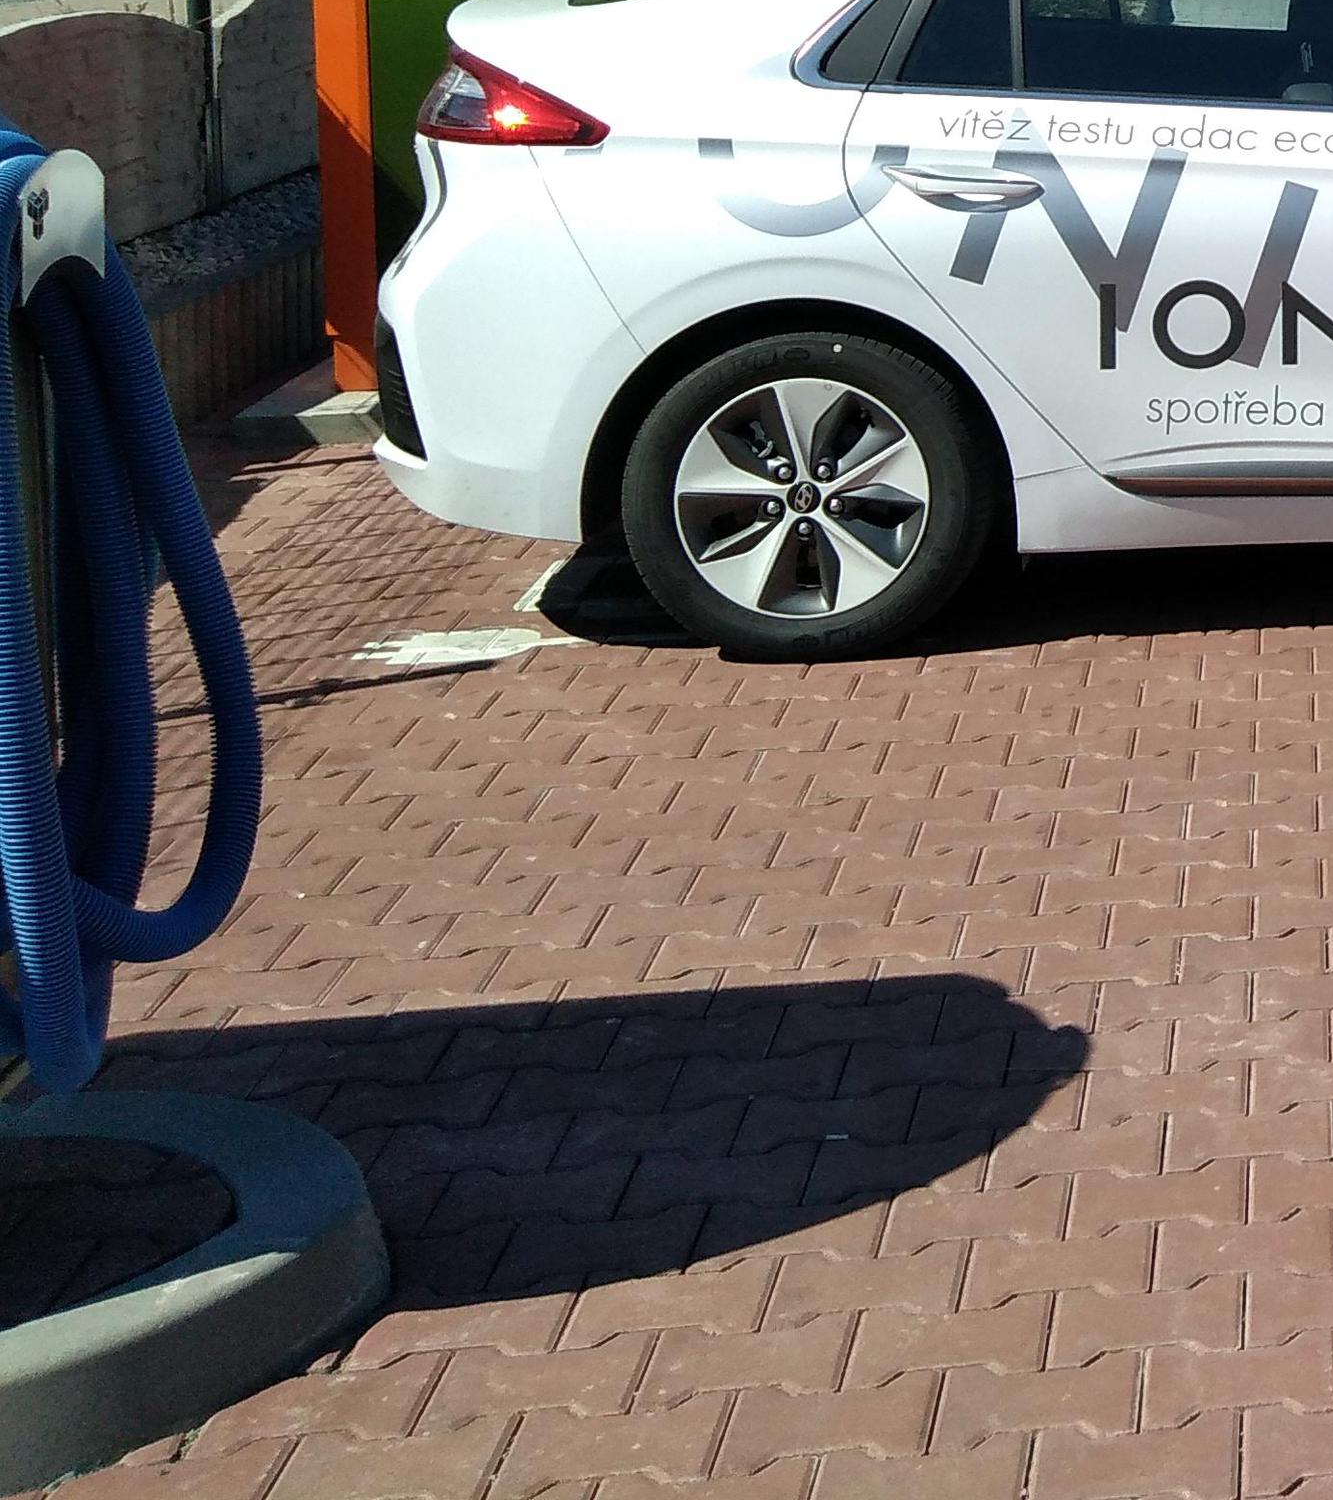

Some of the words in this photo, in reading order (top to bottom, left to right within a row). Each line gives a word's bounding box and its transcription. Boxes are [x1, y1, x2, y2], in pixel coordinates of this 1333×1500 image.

[939, 109, 1032, 142] vítěz
[1047, 115, 1135, 146] testu
[1152, 114, 1258, 151] adac
[1145, 385, 1325, 435] spotřeba
